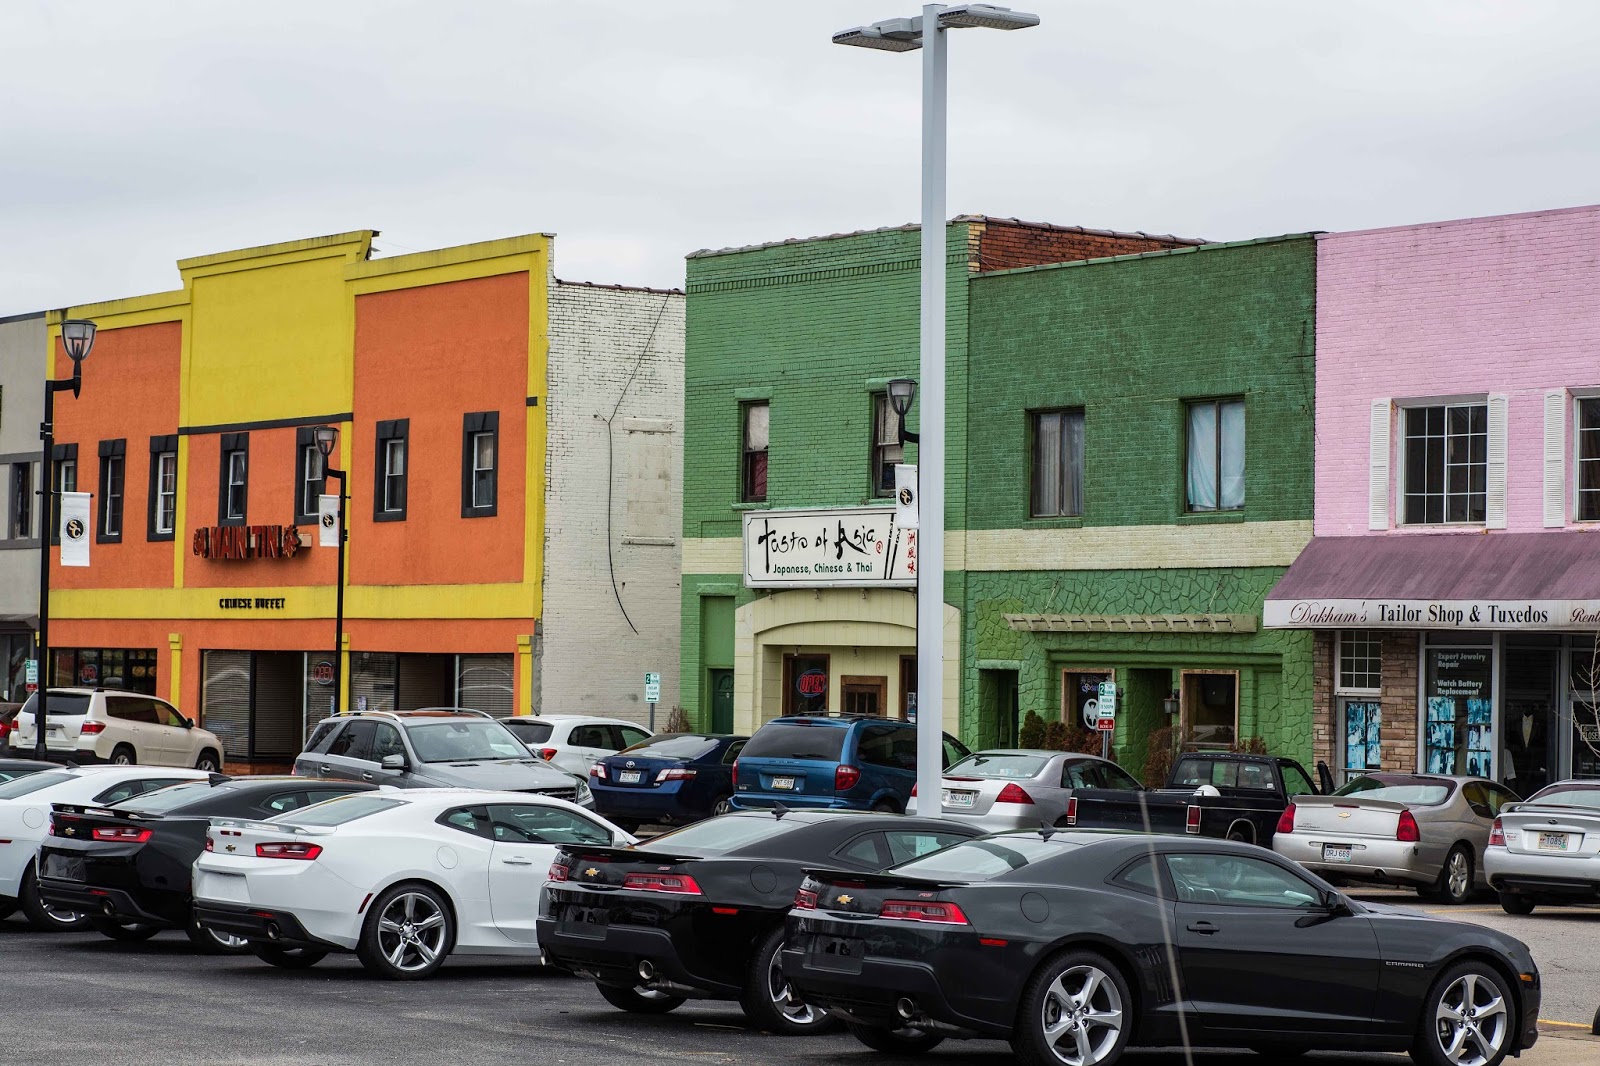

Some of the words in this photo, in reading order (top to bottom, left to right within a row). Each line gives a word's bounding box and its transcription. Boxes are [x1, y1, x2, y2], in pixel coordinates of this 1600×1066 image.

[210, 525, 248, 558] MAIN
[252, 525, 280, 558] TIN
[815, 527, 828, 556] of
[834, 519, 876, 560] Asia
[773, 563, 811, 576] Japanese,
[814, 563, 843, 574] Chinese
[846, 562, 852, 572] &
[856, 561, 873, 573] Thai
[254, 597, 286, 609] BUFFET
[1288, 601, 1368, 624] Dakham's
[1378, 604, 1422, 622] Tailor
[1428, 604, 1463, 626] Shop
[1469, 605, 1481, 623] &
[1488, 605, 1548, 623] Tuxedos
[1570, 607, 1600, 623] Rent
[1437, 652, 1459, 661] Expert
[1460, 652, 1486, 662] Jewelry
[1437, 660, 1460, 670] Repair
[801, 674, 825, 693] OPEN
[1437, 679, 1457, 687] Watch
[1458, 680, 1483, 690] Battery
[1437, 687, 1479, 697] Replacement
[1385, 960, 1424, 968] CAMARO
